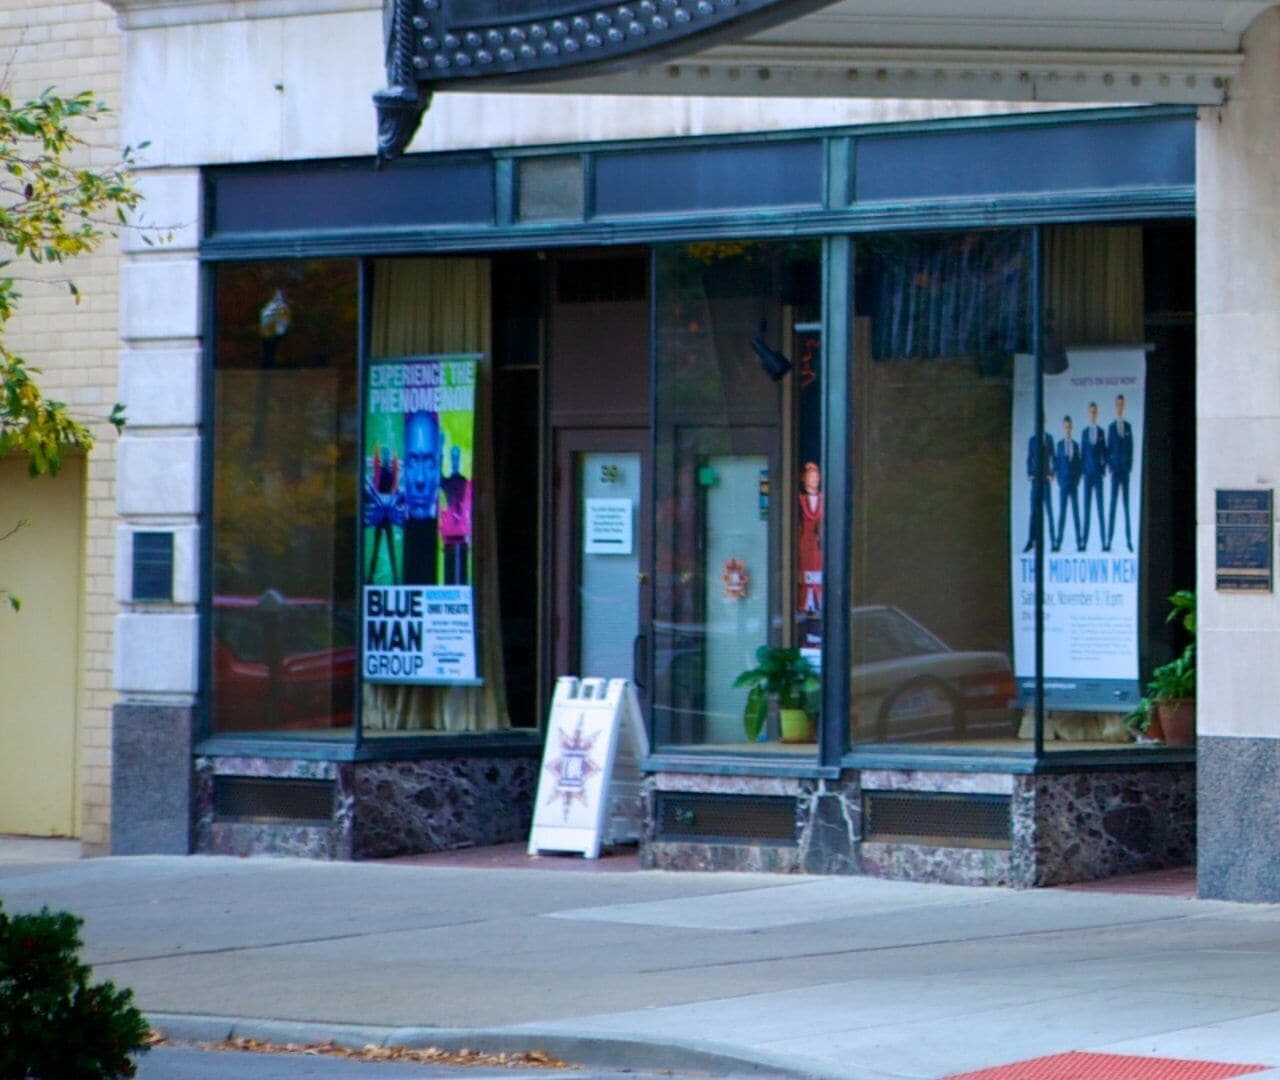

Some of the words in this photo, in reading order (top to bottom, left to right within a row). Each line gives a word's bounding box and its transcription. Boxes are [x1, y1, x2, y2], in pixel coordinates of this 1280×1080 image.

[369, 362, 445, 387] EXPERIENCE
[451, 360, 473, 385] THE
[1049, 558, 1109, 584] MIDTOWN
[367, 589, 424, 618] BLUE
[367, 620, 424, 653] MAN
[366, 655, 424, 676] GROUP
